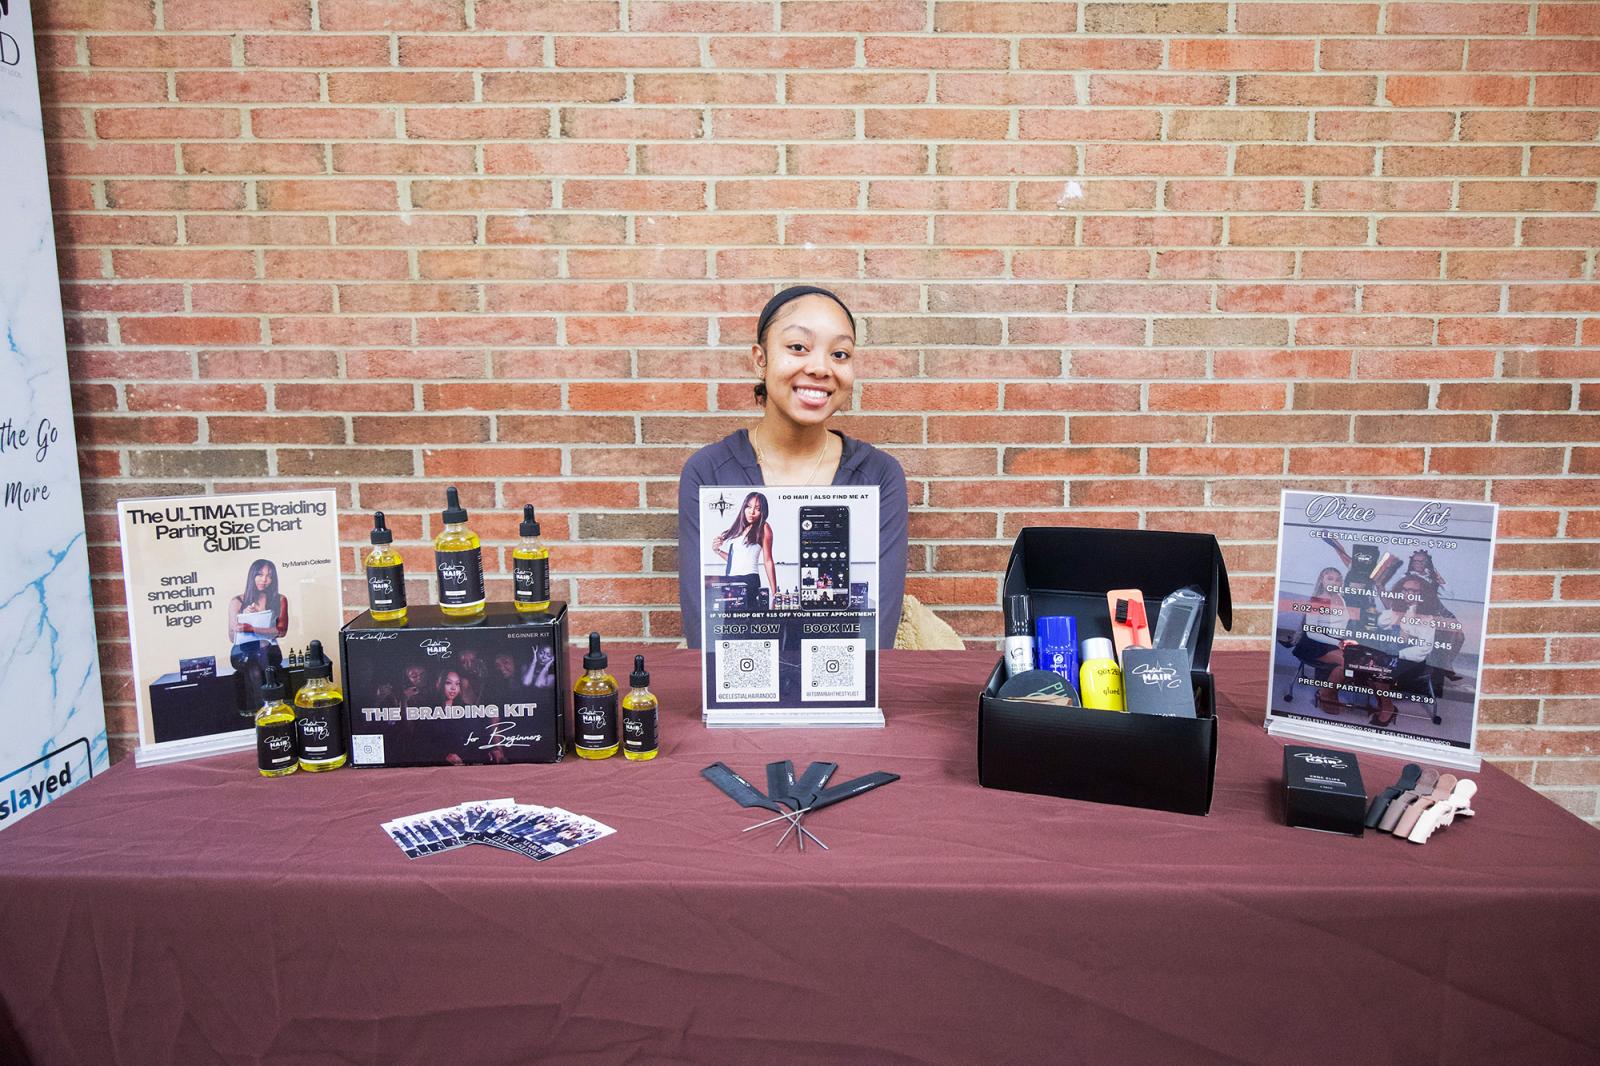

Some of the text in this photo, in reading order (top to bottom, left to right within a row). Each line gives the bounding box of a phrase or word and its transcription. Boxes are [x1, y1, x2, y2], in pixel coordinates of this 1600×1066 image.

[0, 418, 58, 462] the Go
[4, 481, 50, 511] More
[127, 500, 326, 524] The ULTIMATE Braiding
[1306, 495, 1451, 533] Price List
[156, 517, 302, 540] Parting Size Chart
[204, 535, 260, 553] GUIDE
[1310, 530, 1359, 542] CELESTIAL
[1362, 535, 1389, 544] CROC
[1391, 537, 1419, 546] CLIPS
[161, 572, 197, 586] small
[148, 585, 215, 601] smedium
[1326, 585, 1423, 602] CELESTIAL HAIR OIL
[153, 600, 212, 614] medium
[1320, 606, 1343, 616] $8.99
[166, 614, 202, 628] large
[714, 624, 780, 634] SHOP NOW
[804, 624, 860, 633] BOOK ME
[1430, 620, 1462, 630] $11.99
[1303, 624, 1352, 637] BEGINNER
[1355, 632, 1404, 644] BRAIDING
[1407, 638, 1424, 646] KIT
[1434, 642, 1452, 650] $45
[1298, 677, 1334, 688] PRECISE
[1336, 683, 1374, 695] PARTING
[1376, 690, 1402, 699] COMB
[1410, 695, 1434, 704] $2.99
[362, 703, 537, 721] THE BRAIDING KIT
[464, 722, 542, 749] for Beginners
[0, 761, 71, 820] slayed
